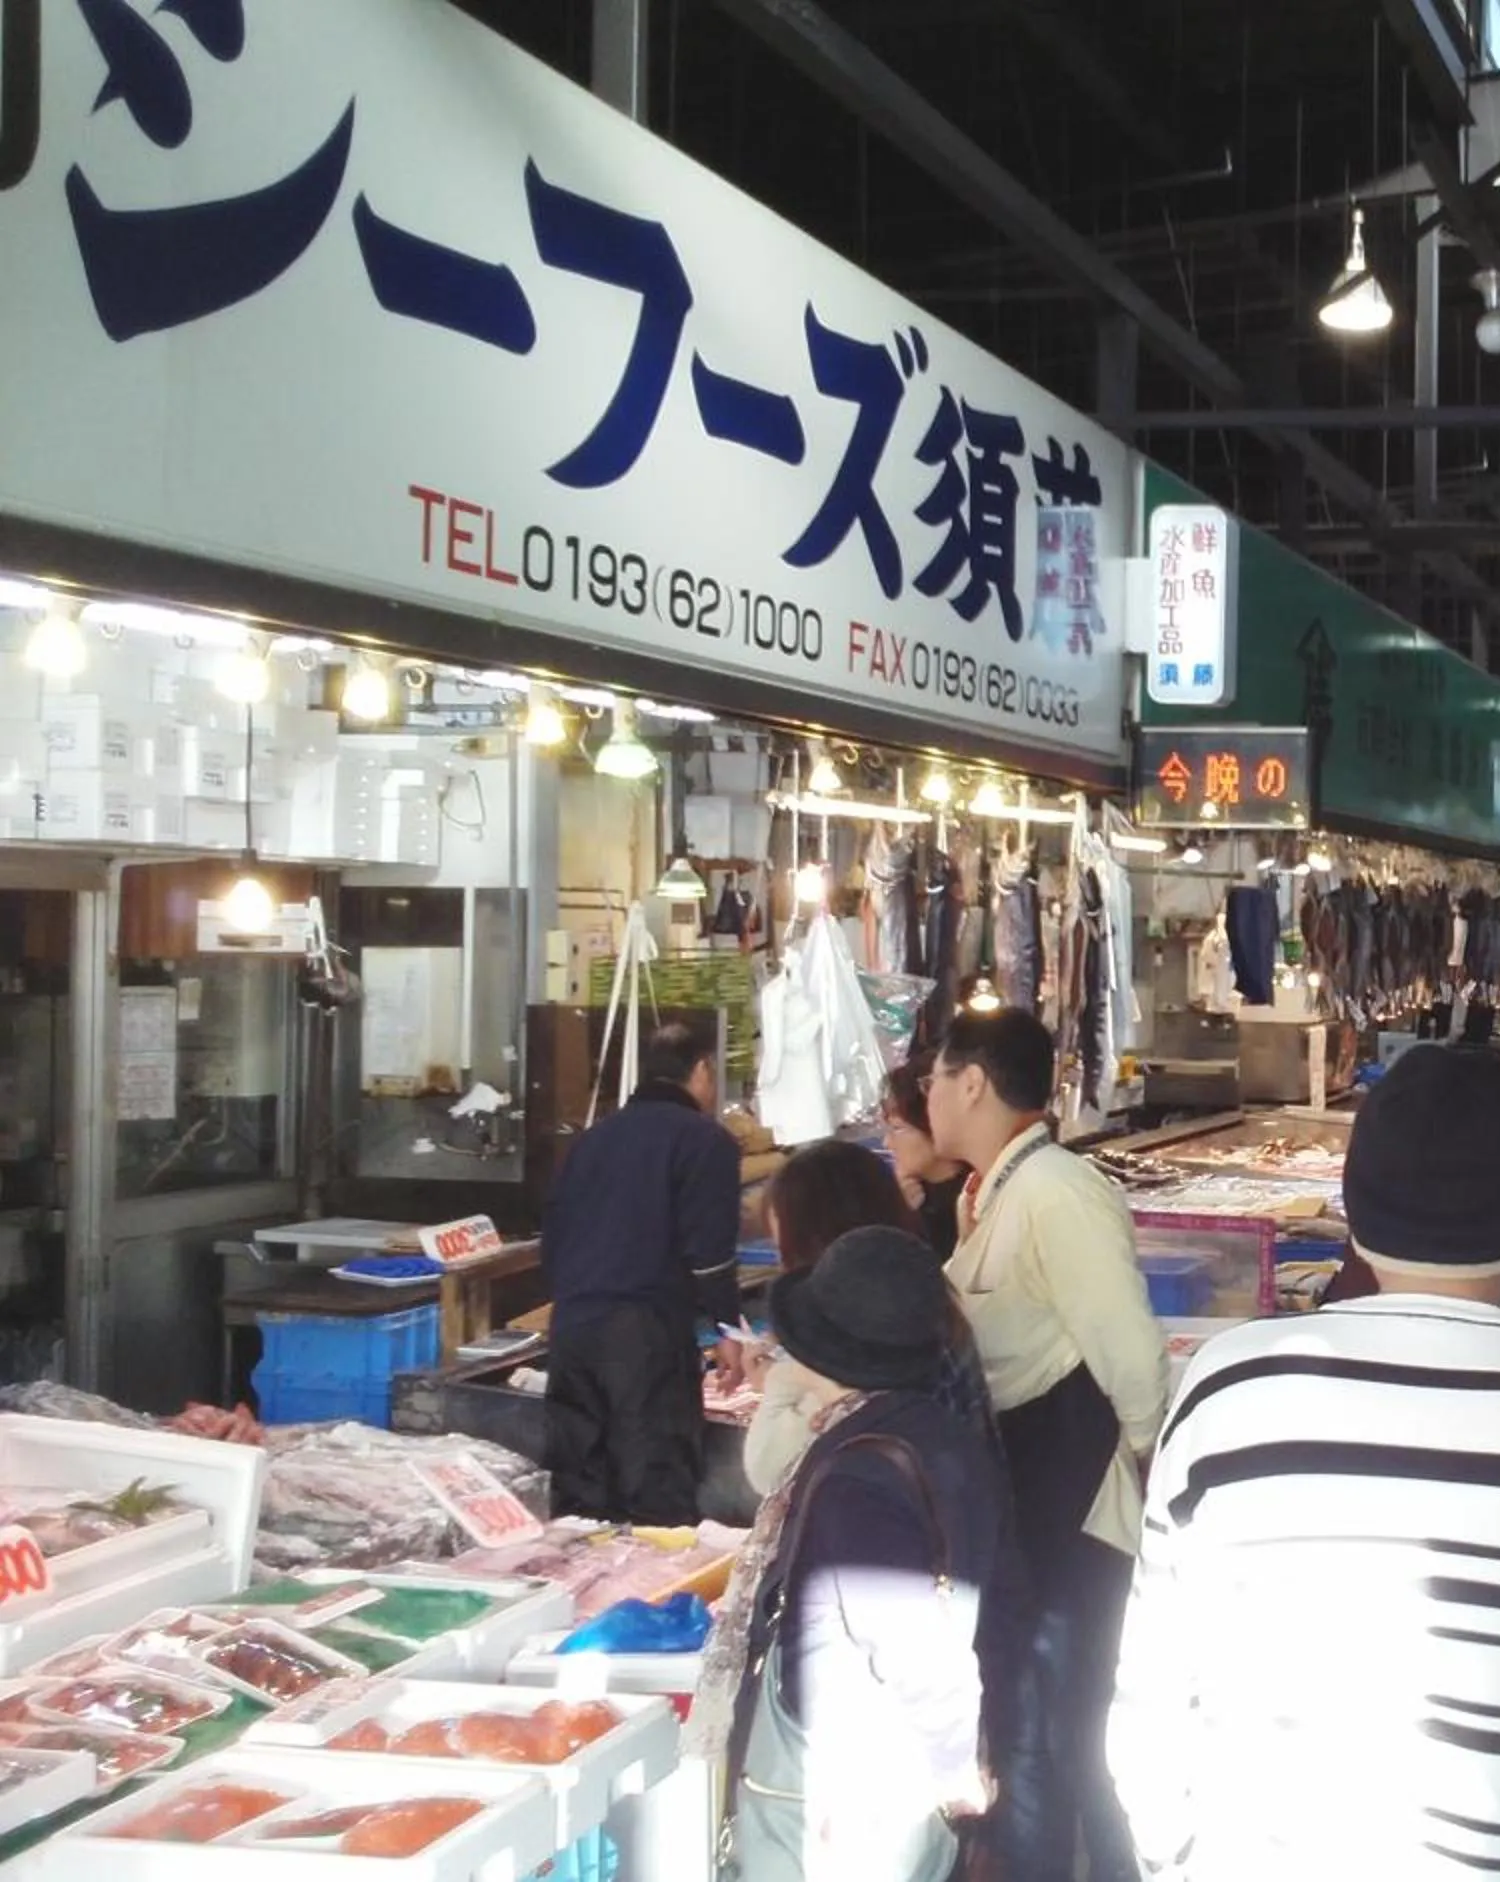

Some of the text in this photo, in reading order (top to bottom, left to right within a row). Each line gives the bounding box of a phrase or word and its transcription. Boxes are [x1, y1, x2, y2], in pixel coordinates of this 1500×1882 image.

[409, 485, 823, 662] TEL 0193(62)1000
[1158, 525, 1186, 655] 水産加工品
[1192, 523, 1218, 599] 鮮魚
[849, 621, 908, 686] FAX
[1159, 752, 1286, 803] 今晩の
[0, 1537, 46, 1602] 00
